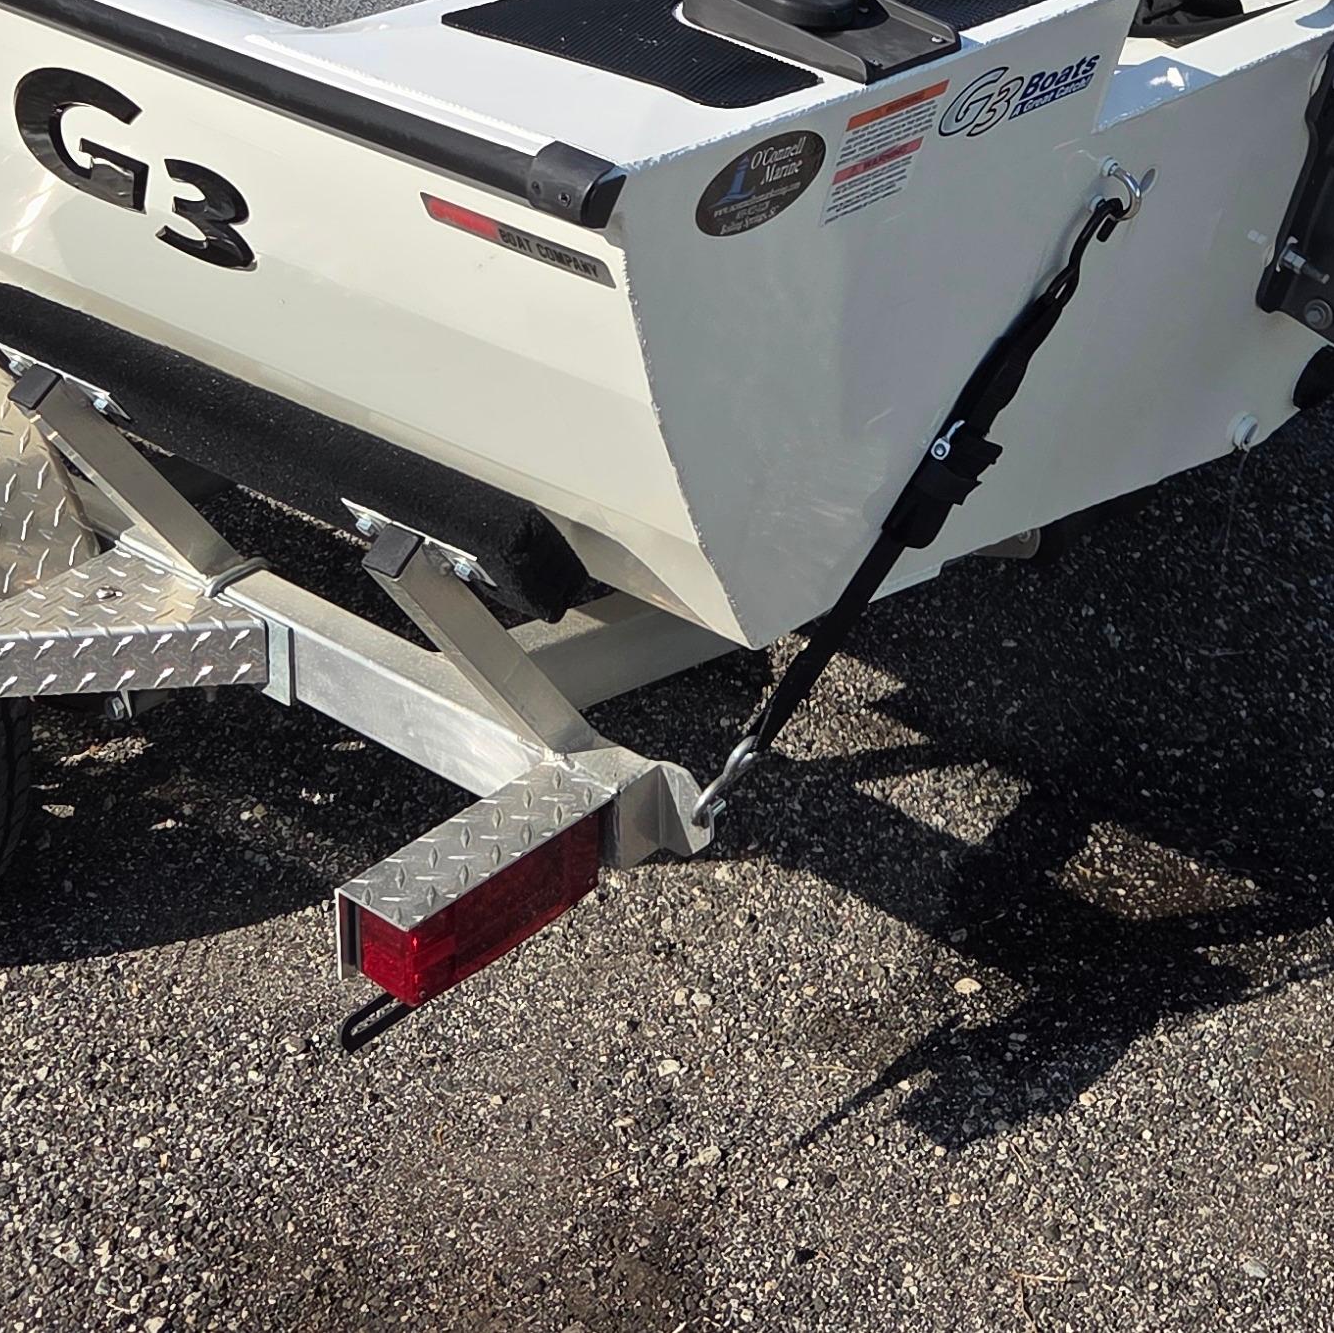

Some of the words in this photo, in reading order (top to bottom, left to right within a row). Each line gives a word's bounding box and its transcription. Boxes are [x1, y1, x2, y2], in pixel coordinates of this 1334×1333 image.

[938, 66, 1025, 137] G3
[1019, 54, 1100, 101] Boats
[1023, 93, 1056, 112] Great
[14, 66, 258, 272] G3
[750, 135, 807, 170] O'Connell
[759, 158, 803, 185] Marine
[498, 228, 533, 254] BOAT
[536, 242, 599, 278] COMPANY
